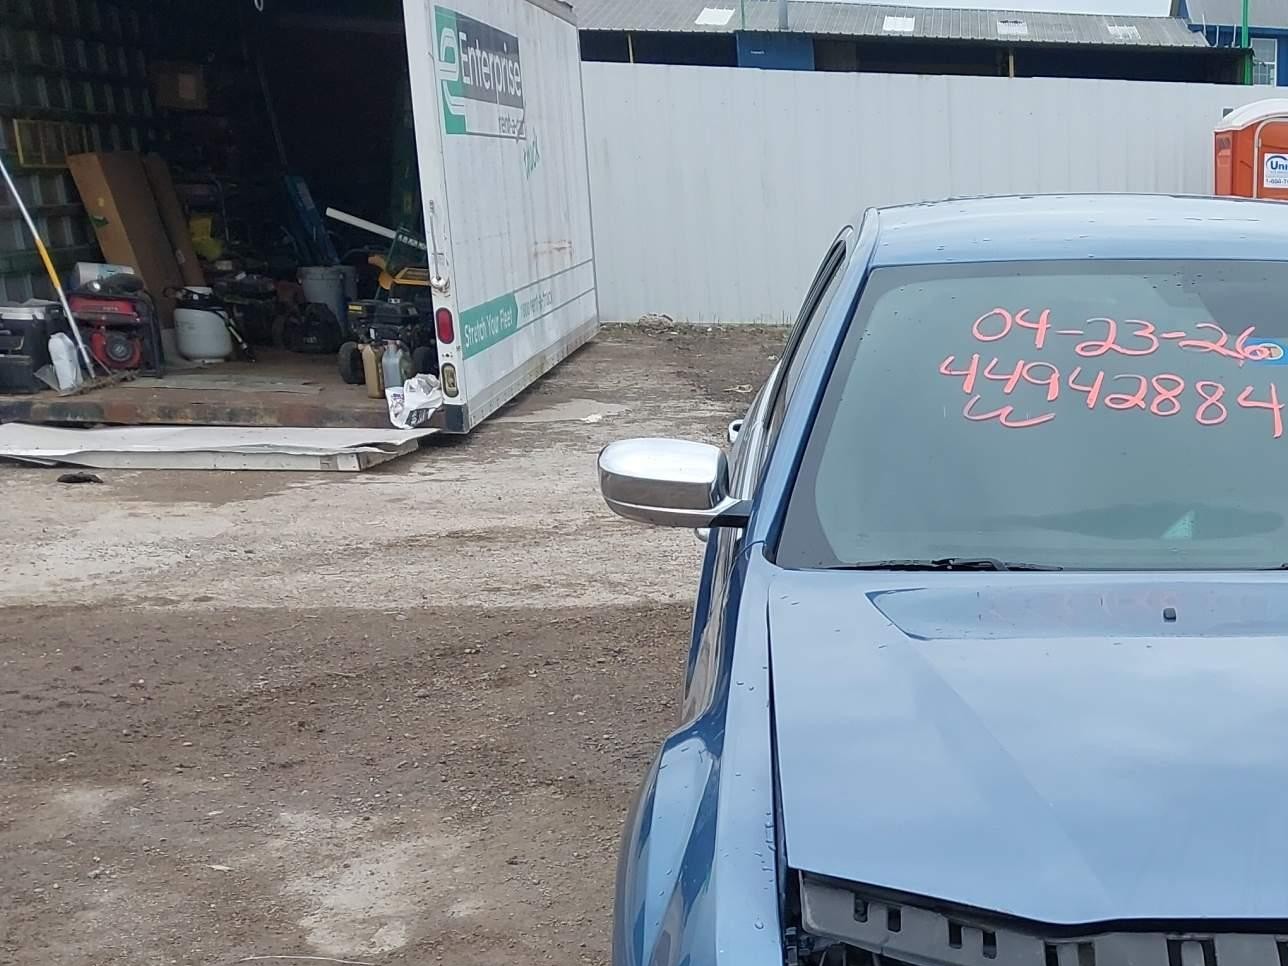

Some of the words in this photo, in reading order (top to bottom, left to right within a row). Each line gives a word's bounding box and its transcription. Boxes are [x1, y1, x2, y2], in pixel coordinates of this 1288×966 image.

[458, 31, 522, 105] Enterprise
[464, 317, 487, 348] Stretch
[487, 312, 500, 337] Your
[500, 307, 513, 331] Fleet
[972, 308, 1271, 366] 04-23-26
[939, 353, 1285, 439] 44942884
